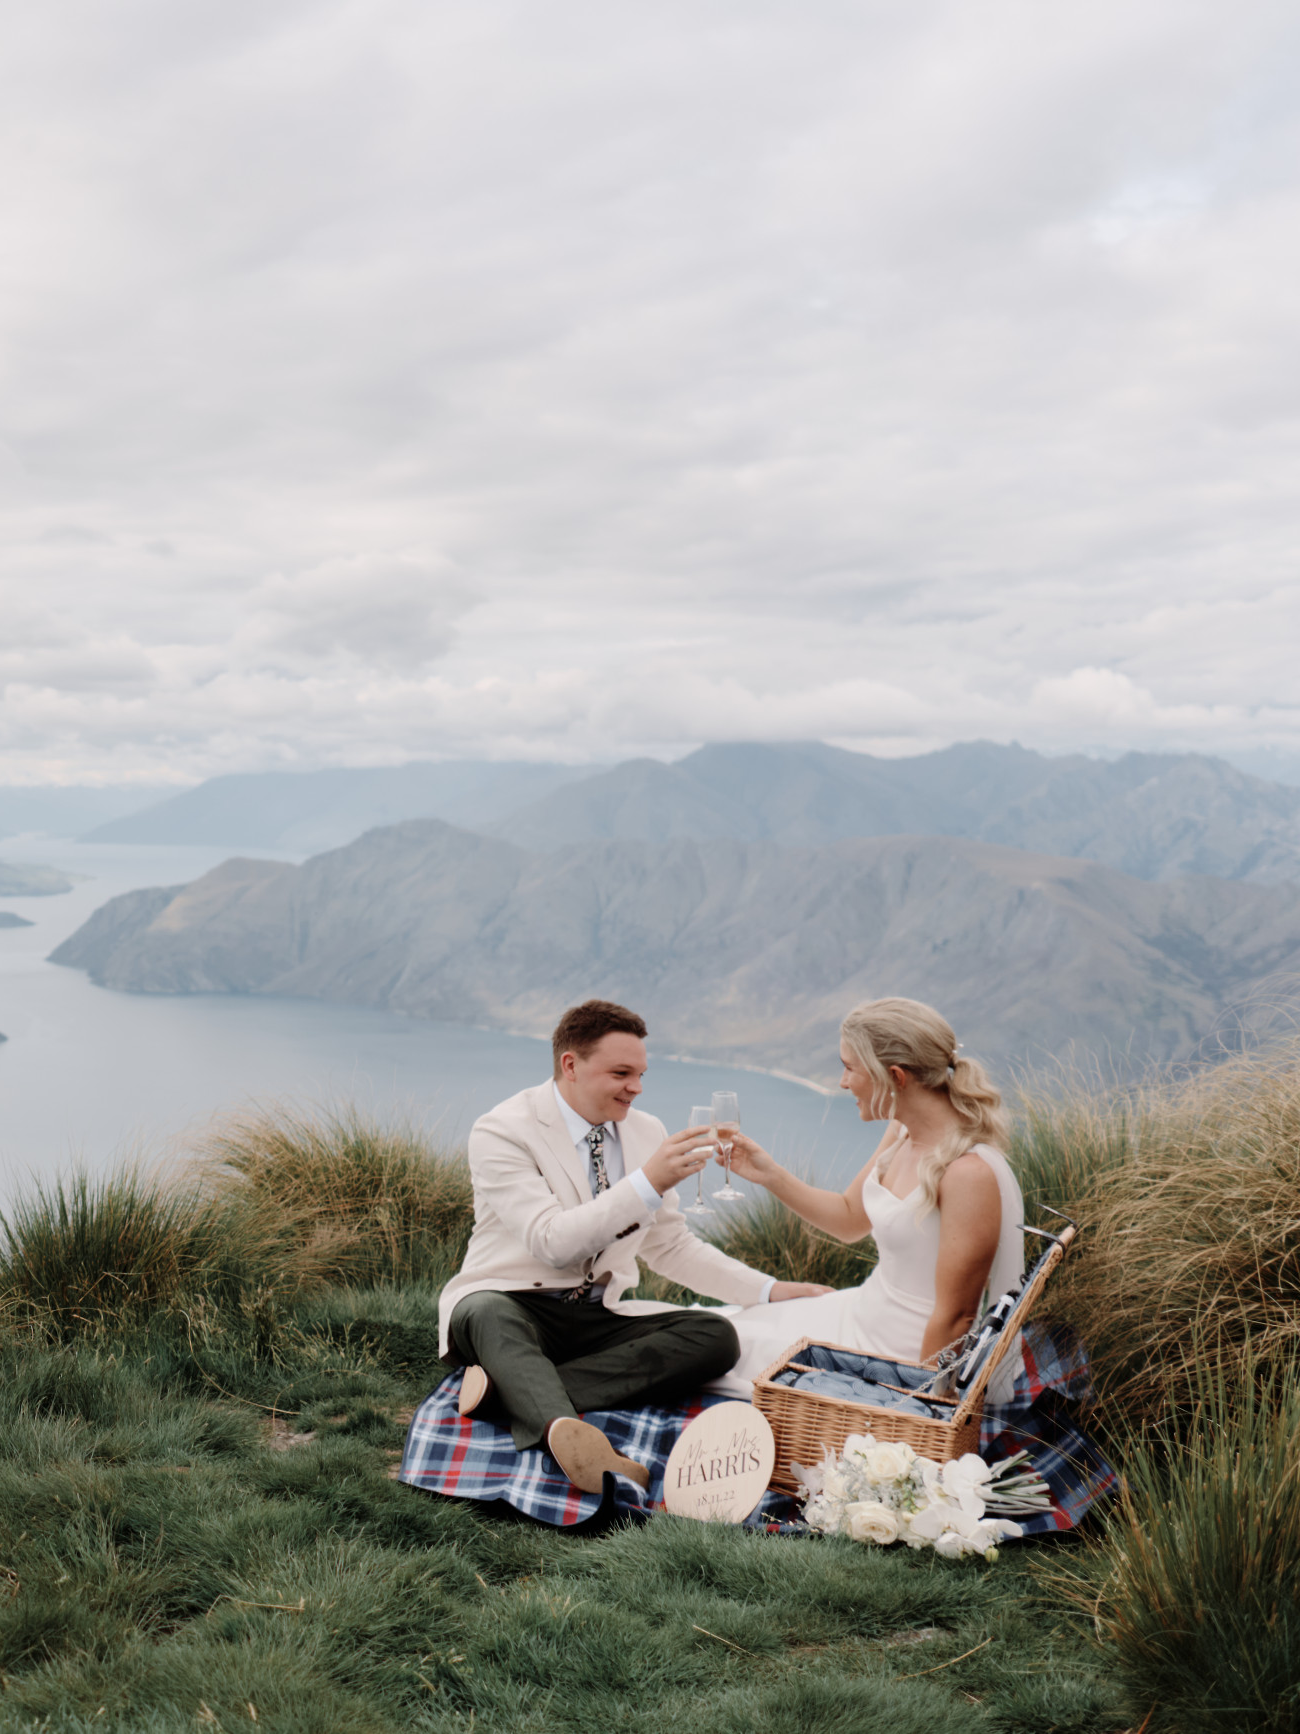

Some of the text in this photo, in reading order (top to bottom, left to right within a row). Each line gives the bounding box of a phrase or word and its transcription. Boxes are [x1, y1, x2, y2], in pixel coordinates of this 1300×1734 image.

[683, 1439, 707, 1467] Mr
[727, 1427, 759, 1457] Mrs
[677, 1448, 760, 1489] HARRIS
[697, 1490, 735, 1507] 18.11.22
